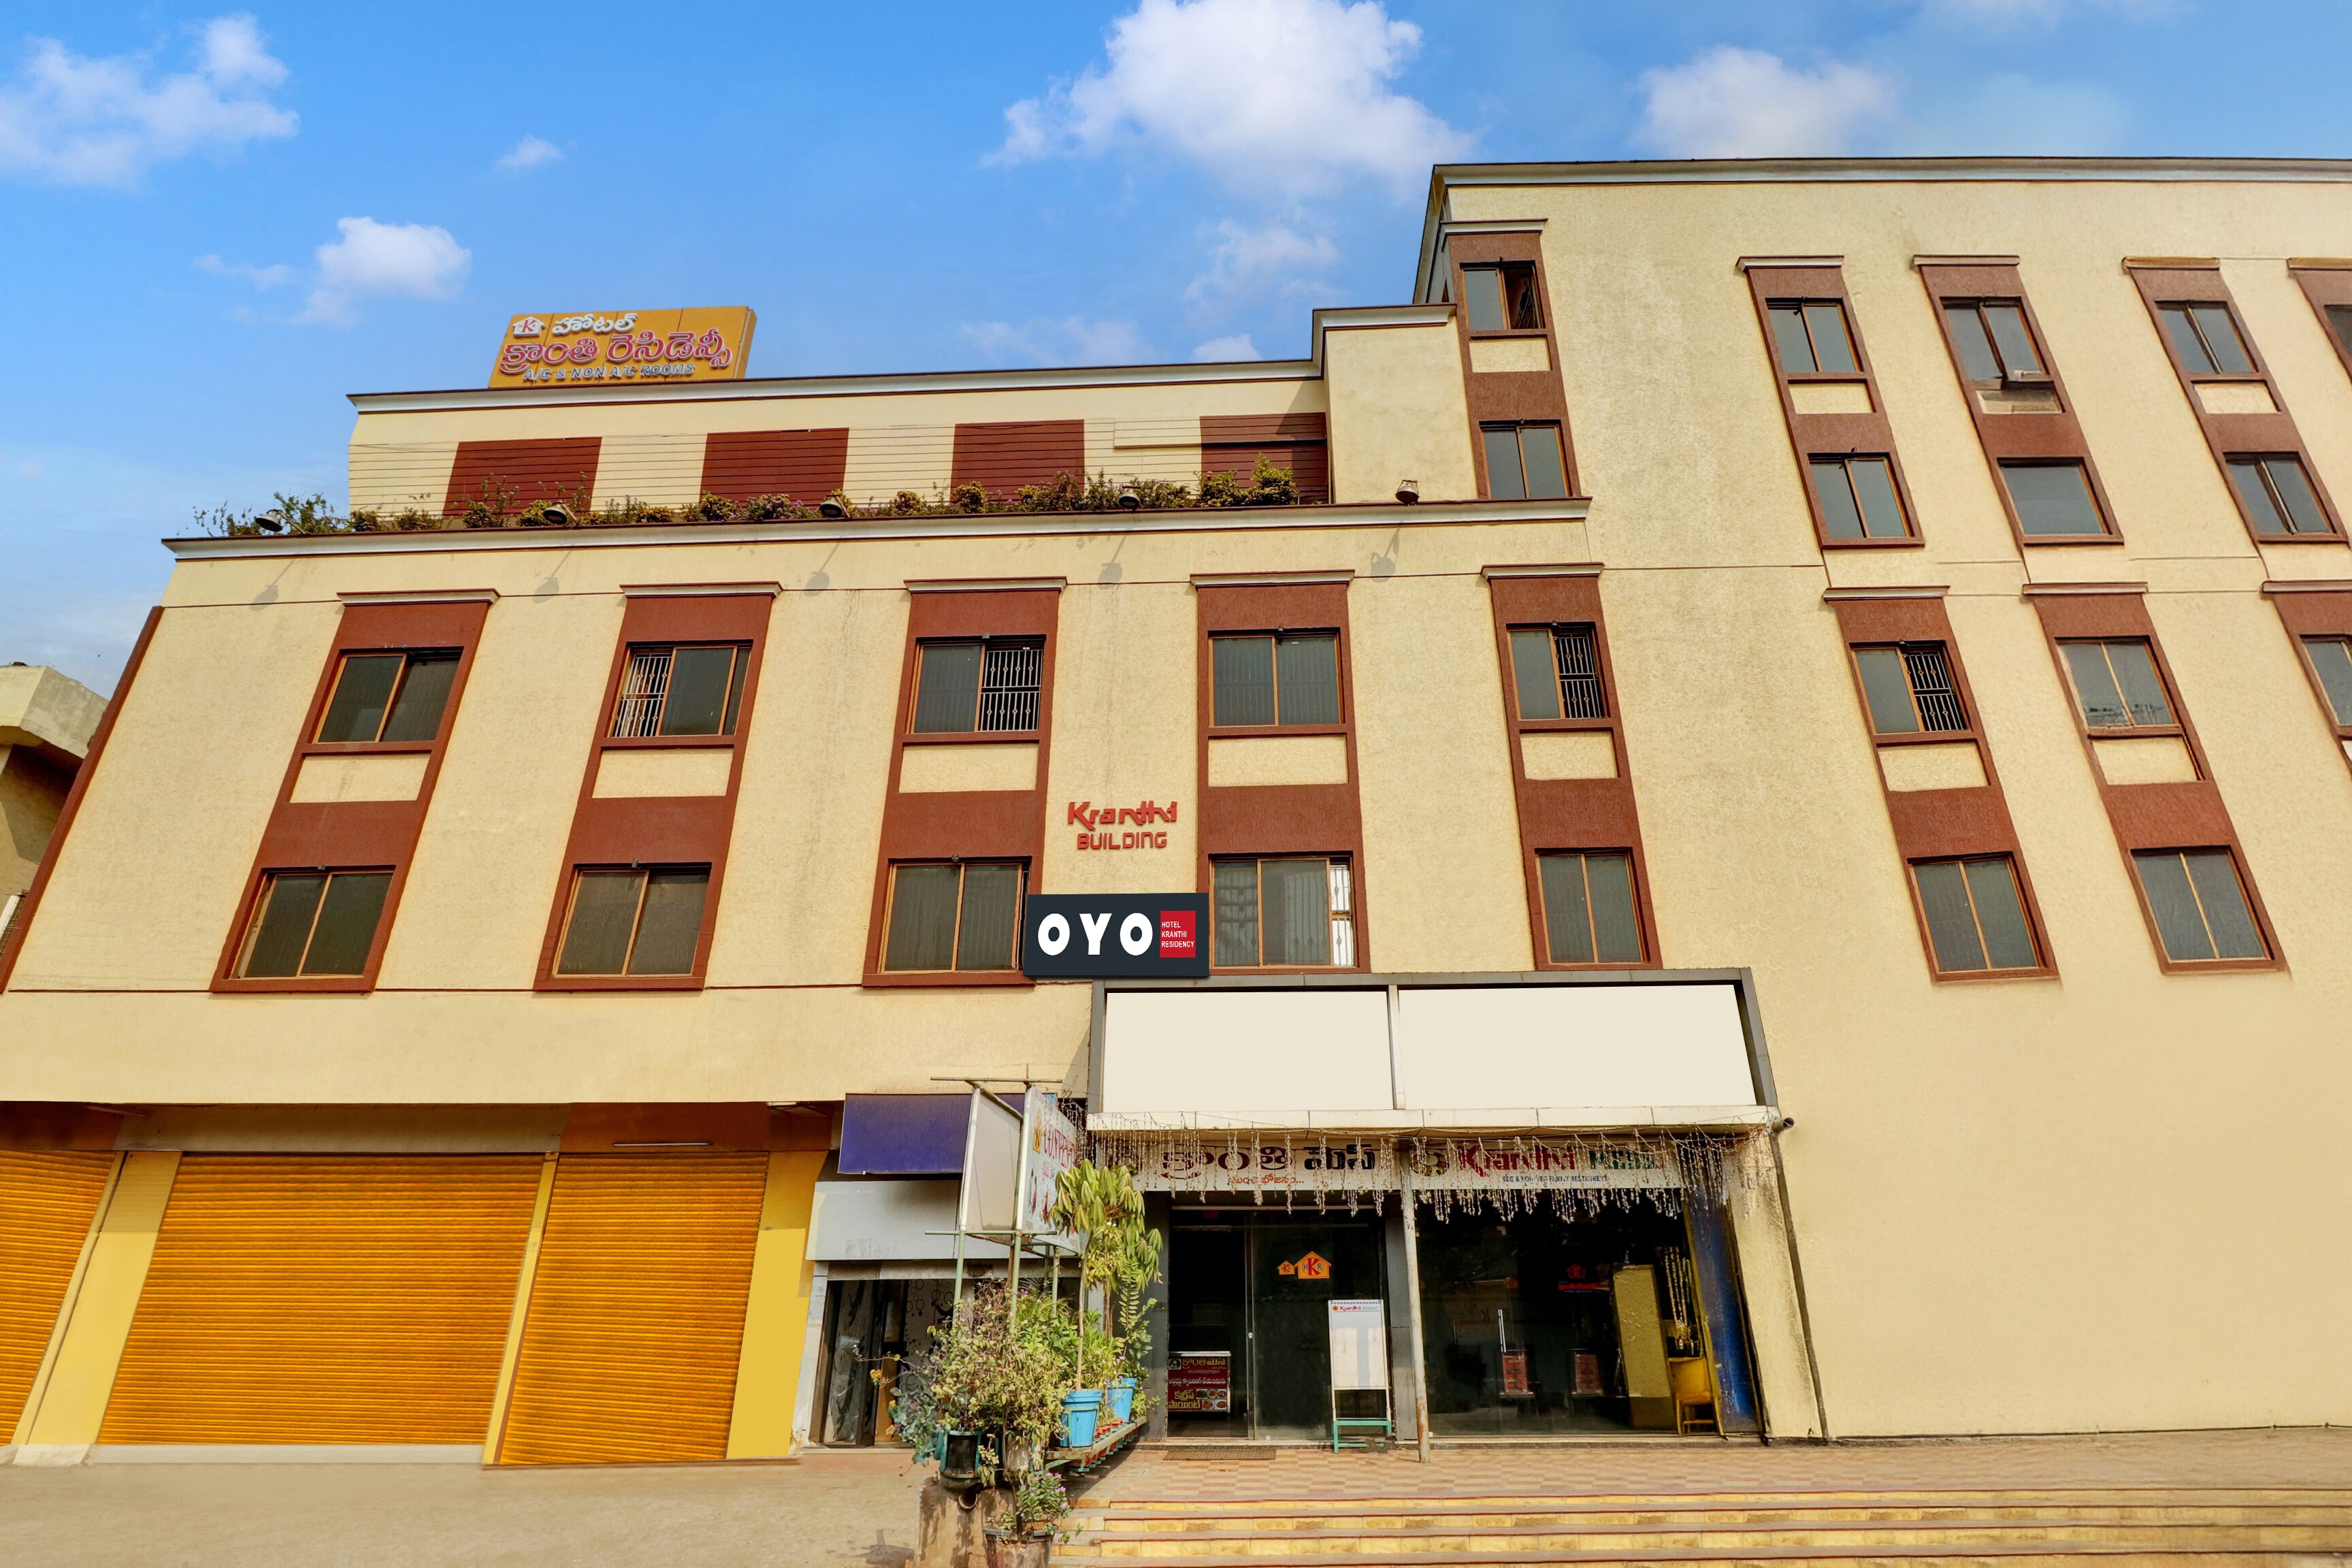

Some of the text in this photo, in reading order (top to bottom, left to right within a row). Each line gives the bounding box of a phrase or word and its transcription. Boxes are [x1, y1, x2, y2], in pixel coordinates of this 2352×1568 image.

[552, 313, 638, 336] హోటల్
[500, 327, 733, 374] క్రాంతి రెసిడెన్సీ
[523, 363, 695, 380] A/C & NON A/C ROOMS
[1067, 800, 1177, 831] Kranthi
[1077, 831, 1167, 849] BUILDING
[1038, 913, 1153, 956] OYO
[1457, 1145, 1575, 1177] Kranthi
